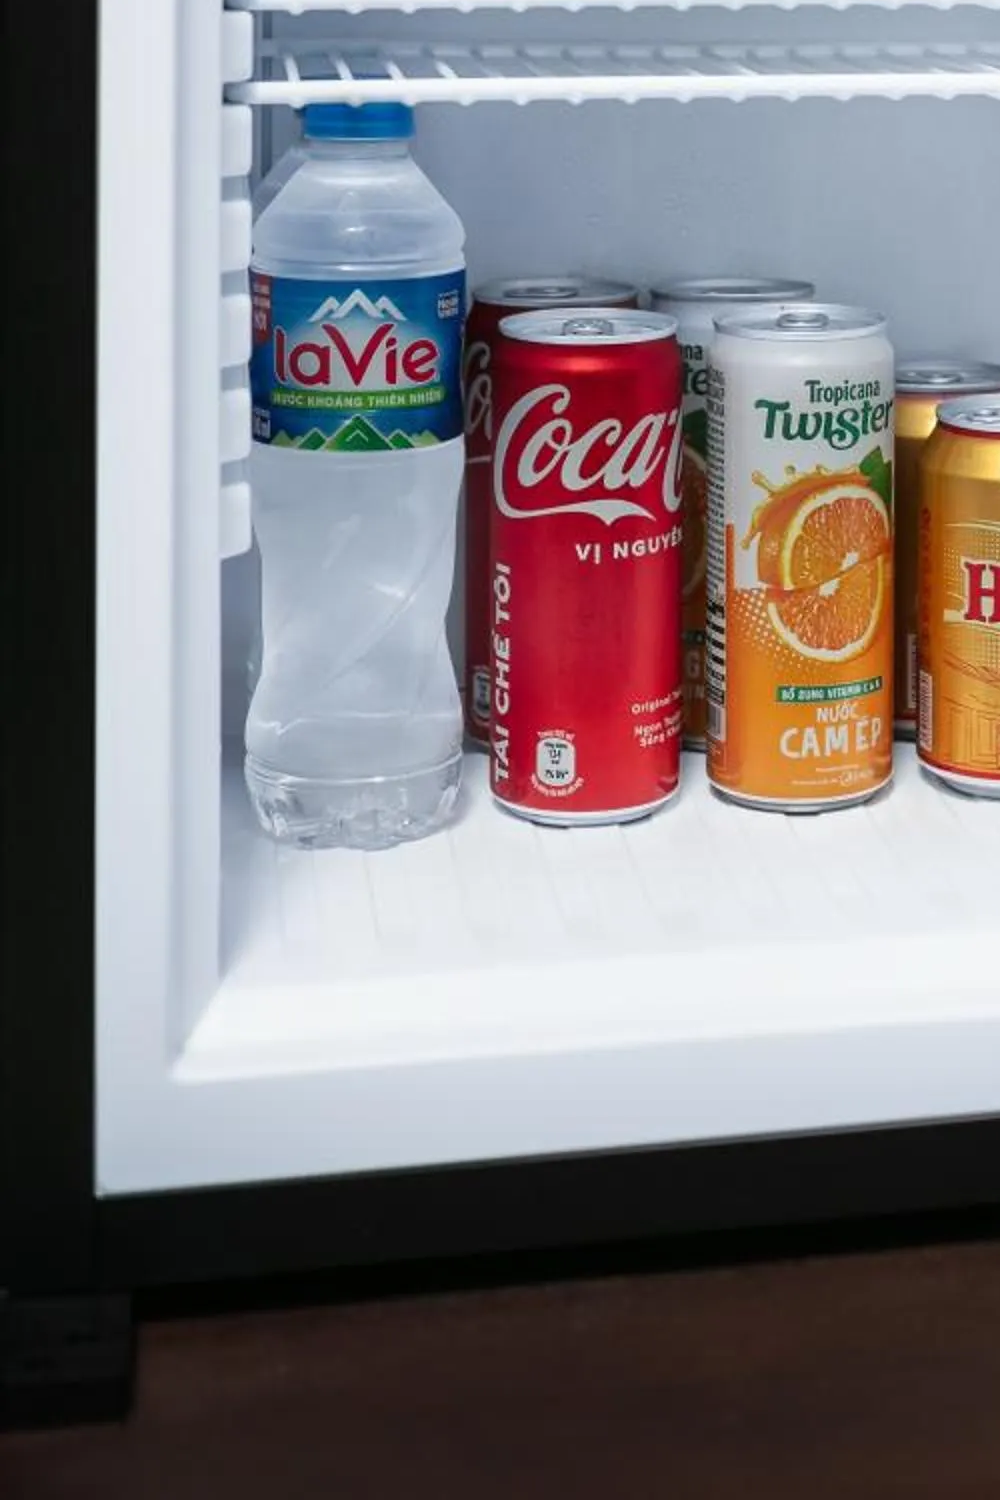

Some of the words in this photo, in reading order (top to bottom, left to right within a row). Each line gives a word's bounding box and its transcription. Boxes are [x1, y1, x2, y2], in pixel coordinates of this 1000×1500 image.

[804, 379, 880, 406] Tropicana
[754, 398, 893, 450] Twister
[575, 542, 601, 565] VỊ
[780, 725, 850, 759] CAM
